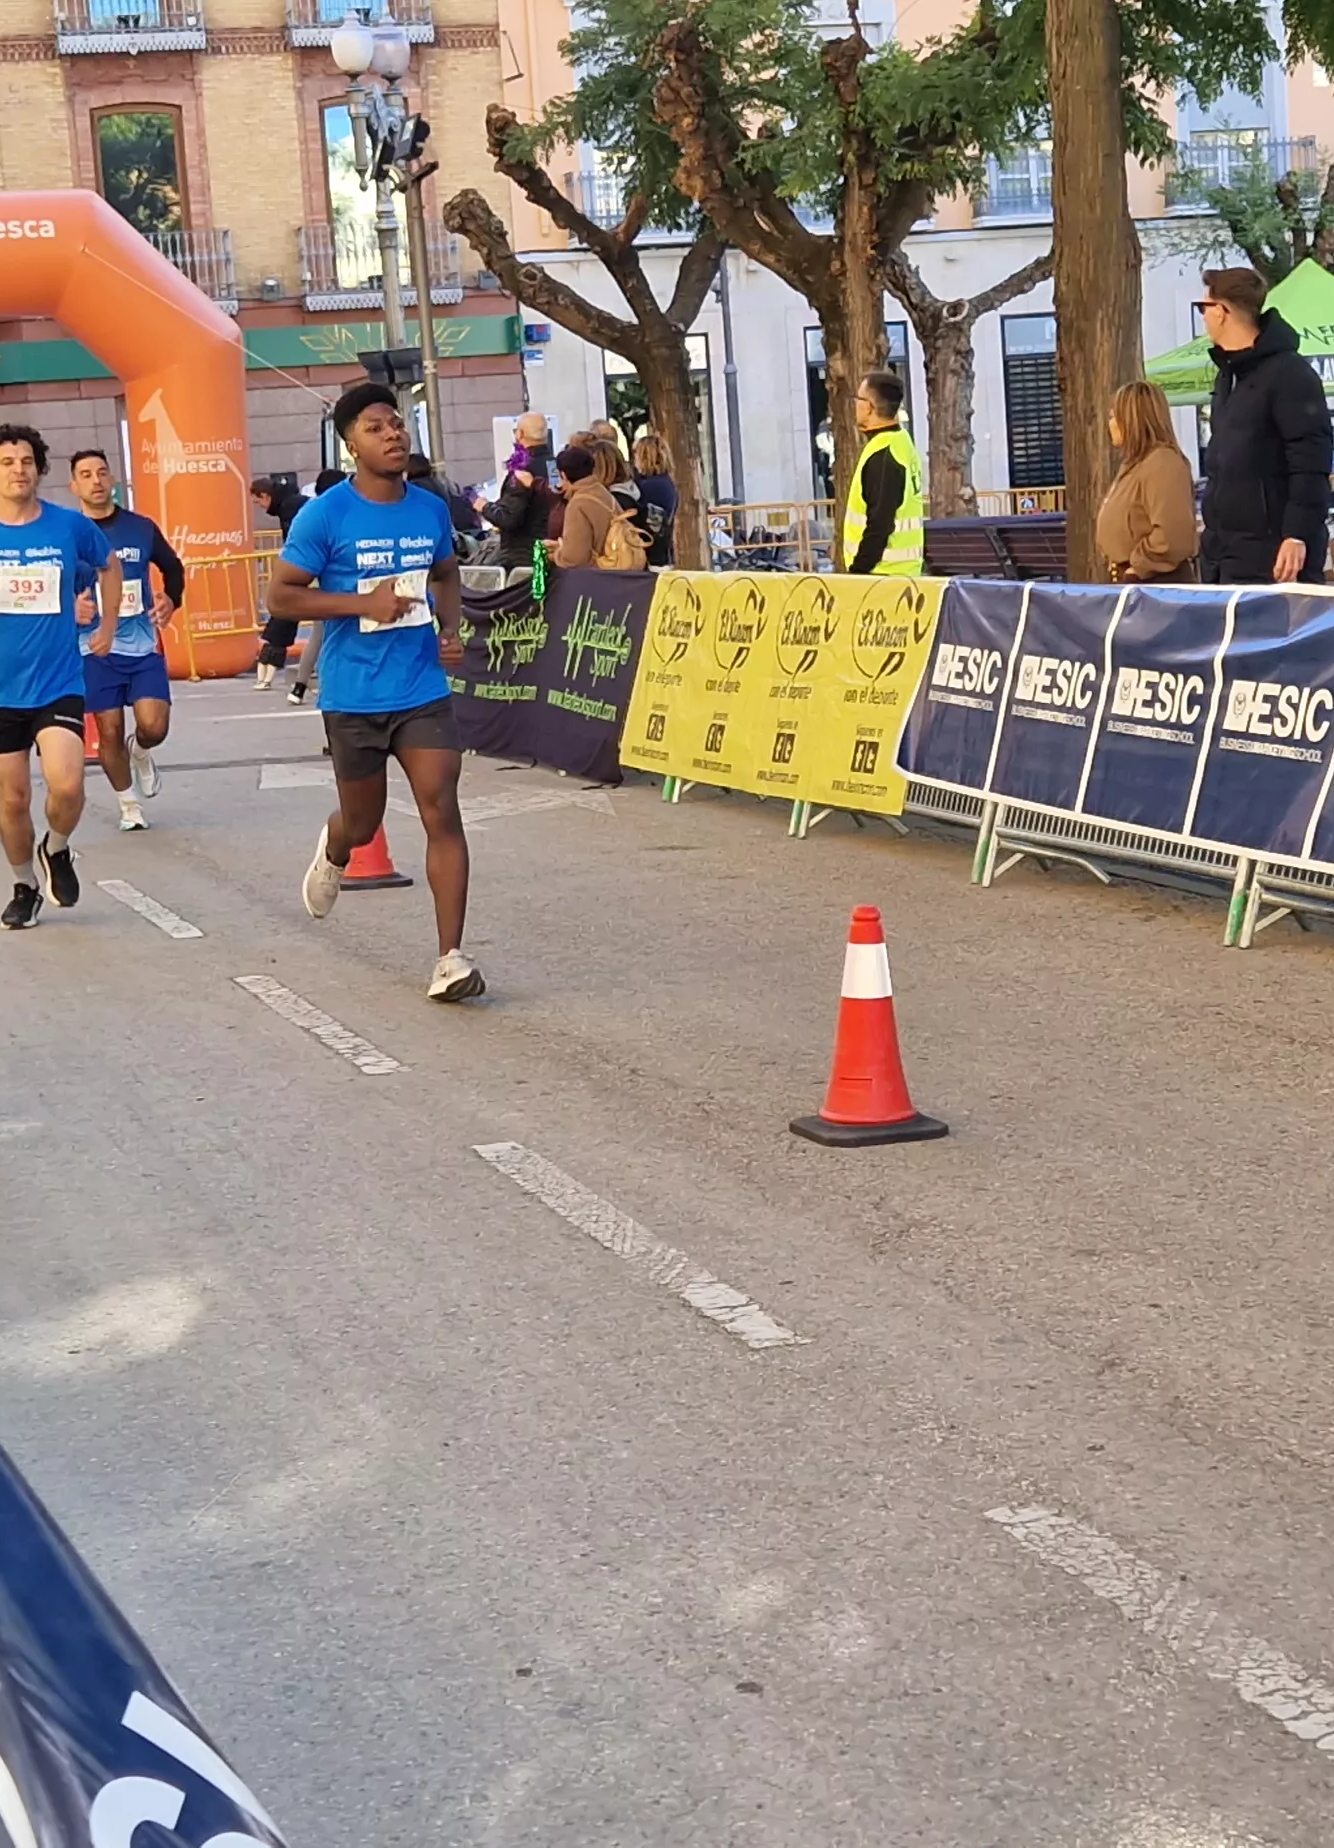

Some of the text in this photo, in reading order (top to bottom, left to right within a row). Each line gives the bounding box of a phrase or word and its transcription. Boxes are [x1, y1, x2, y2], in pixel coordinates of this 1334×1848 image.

[142, 458, 226, 474] de Huesca
[170, 525, 243, 547] Hacemos
[356, 551, 395, 567] NEXT
[9, 579, 45, 594] 393
[948, 644, 1002, 695] ESIC
[1033, 656, 1097, 709] ESIC
[1131, 668, 1204, 725] ESIC
[1248, 682, 1334, 742] ESIC
